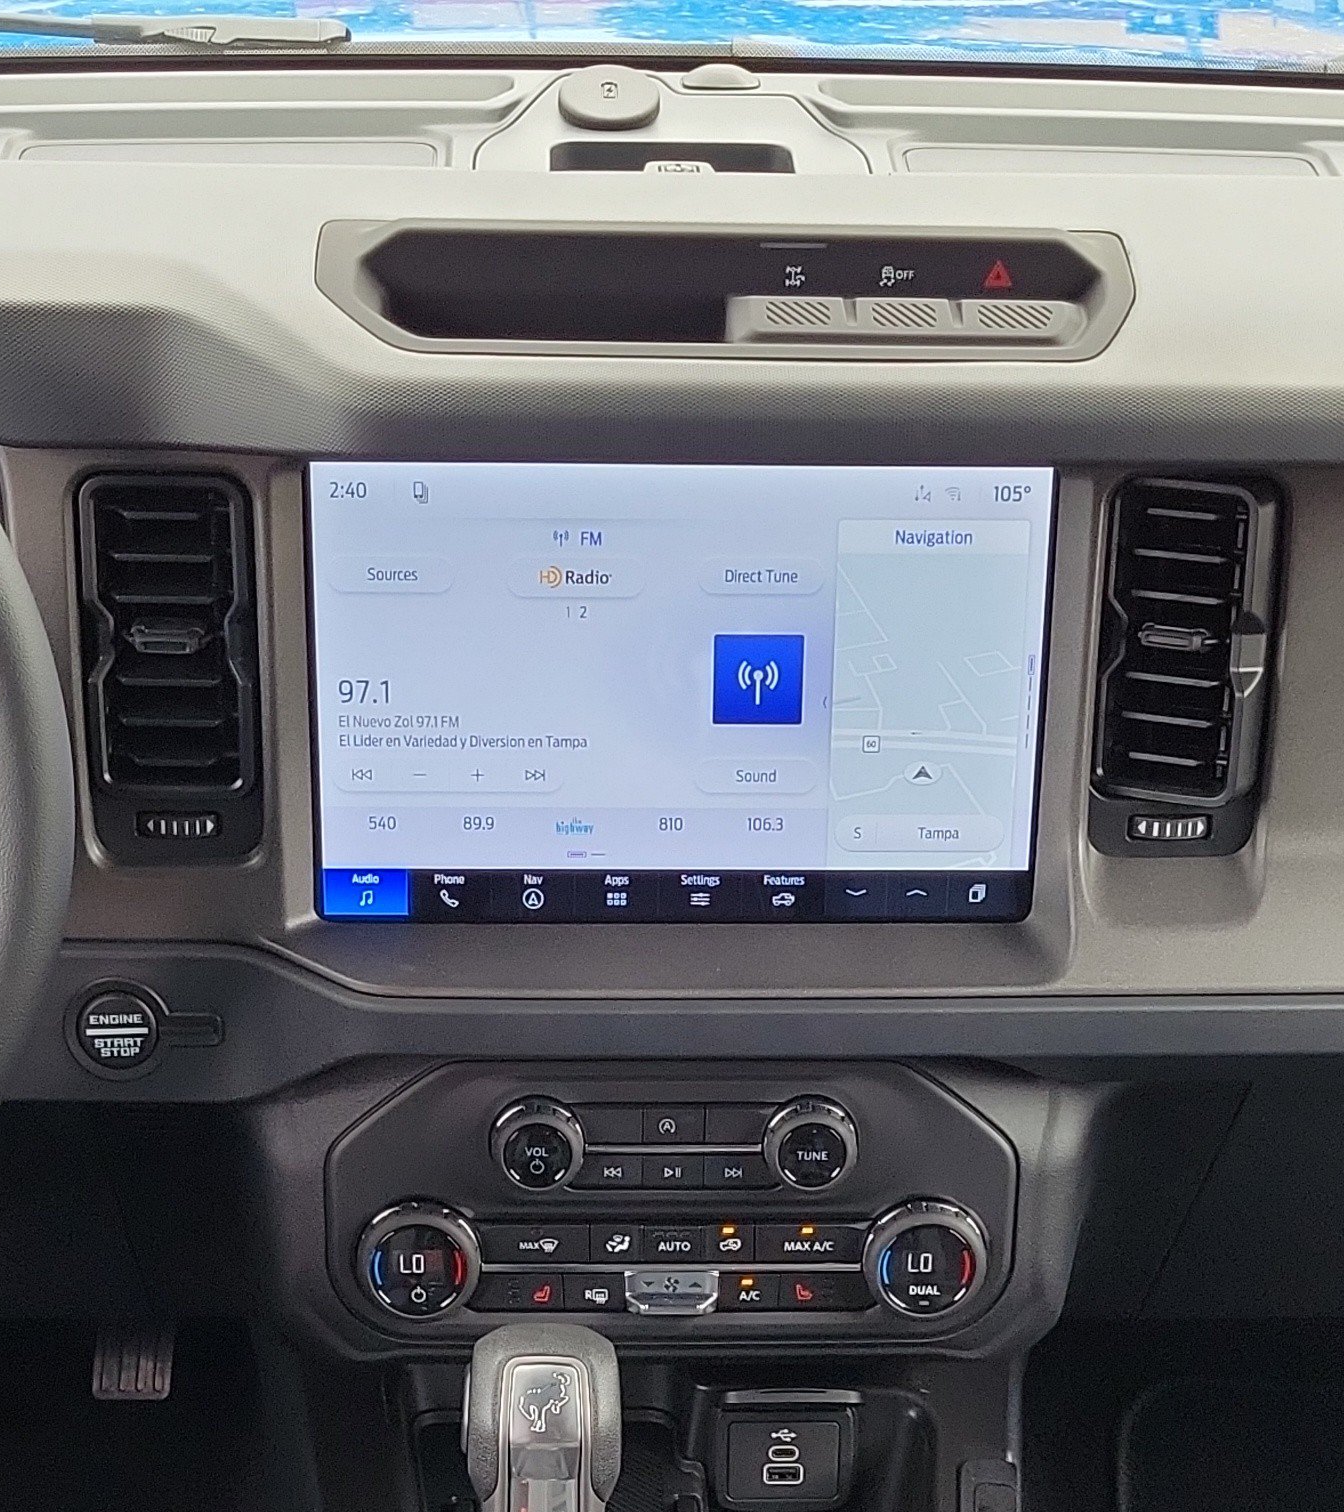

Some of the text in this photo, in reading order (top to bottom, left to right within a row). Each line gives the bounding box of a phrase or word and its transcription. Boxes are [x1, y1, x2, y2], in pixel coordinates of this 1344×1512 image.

[896, 270, 915, 281] OFF
[329, 481, 367, 499] 2:40
[994, 485, 1032, 502] 105°
[580, 531, 602, 547] FM
[895, 529, 973, 548] Navigation
[367, 567, 418, 581] Sources
[565, 569, 612, 585] Radio
[724, 569, 798, 583] Direct Tune
[579, 606, 587, 618] 2
[338, 680, 391, 704] 97.1
[338, 715, 459, 728] El Nuevo Zol 97.1 FM
[339, 735, 351, 747] El
[386, 737, 401, 748] en
[404, 735, 457, 748] Variedad
[460, 738, 467, 750] y
[469, 735, 525, 748] Diversion
[527, 737, 543, 748] en
[545, 735, 588, 751] Tampa
[866, 740, 877, 749] 60
[736, 769, 777, 783] Sound
[368, 816, 397, 830] 540
[463, 816, 495, 830] 89.9
[556, 821, 594, 836] highway
[658, 818, 683, 832] 810
[747, 818, 784, 832] 106.3
[853, 827, 862, 839] S
[918, 827, 959, 841] Tampa
[352, 874, 380, 885] Audio
[434, 874, 465, 885] Phone
[523, 874, 542, 885] Nav
[604, 874, 629, 887] Apps
[680, 874, 721, 887] Settings
[763, 874, 805, 885] Features
[89, 1014, 144, 1025] ENGINE
[94, 1037, 145, 1048] START
[100, 1047, 140, 1057] STOP
[524, 1146, 550, 1158] VOL
[796, 1150, 829, 1161] TUNE
[519, 1241, 540, 1251] MAX
[658, 1241, 691, 1251] AUTO
[783, 1240, 835, 1252] MAX A/C
[399, 1253, 425, 1274] LO
[907, 1252, 932, 1273] LO
[739, 1290, 761, 1301] A/C
[909, 1285, 940, 1296] DUAL
